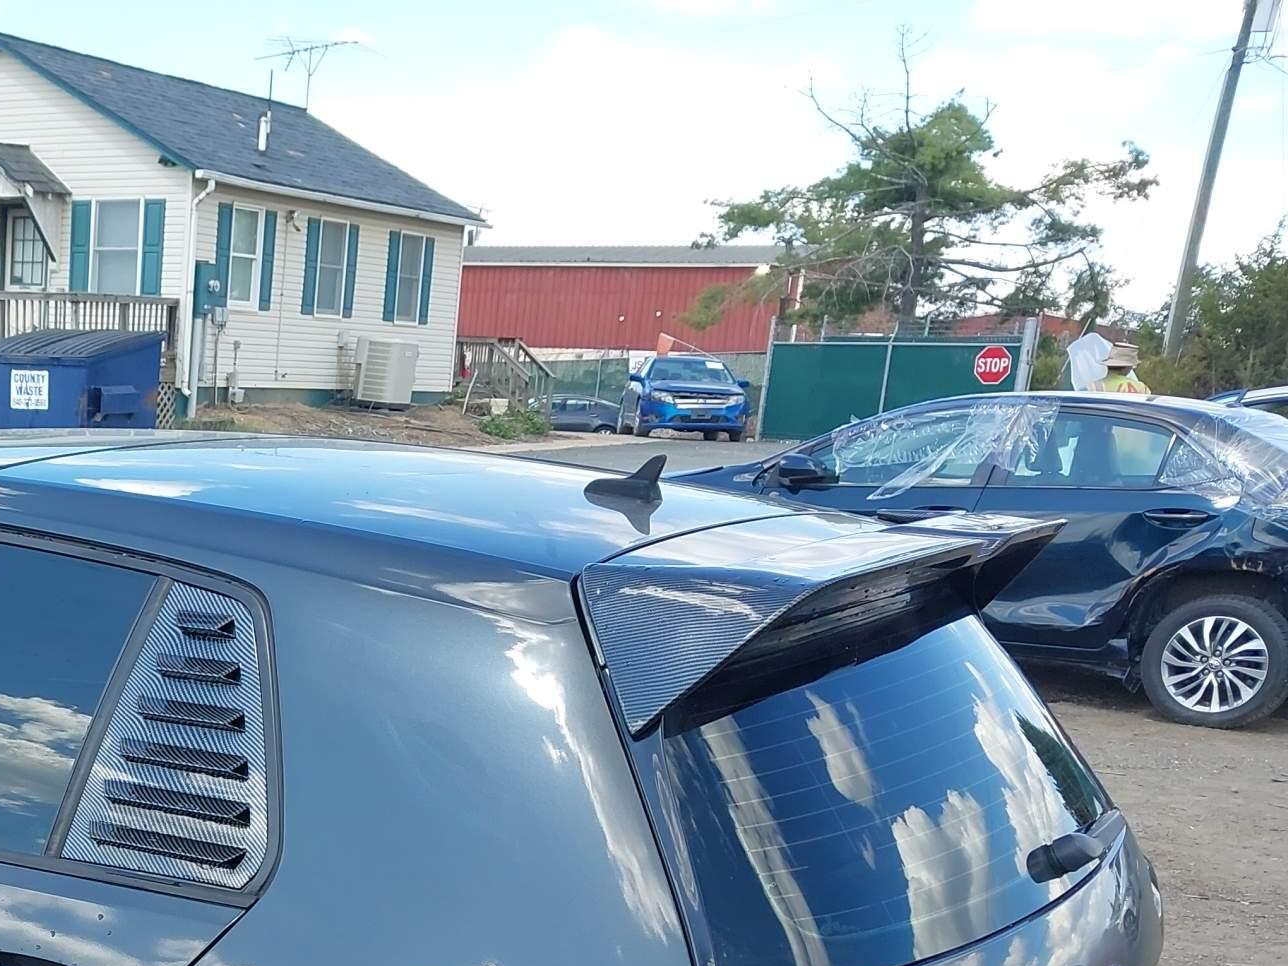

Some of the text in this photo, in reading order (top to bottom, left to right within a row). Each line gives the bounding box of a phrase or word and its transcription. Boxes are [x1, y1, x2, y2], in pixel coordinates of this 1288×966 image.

[977, 357, 1009, 373] STOP
[14, 373, 46, 383] COUNTY
[15, 385, 43, 396] WASTE
